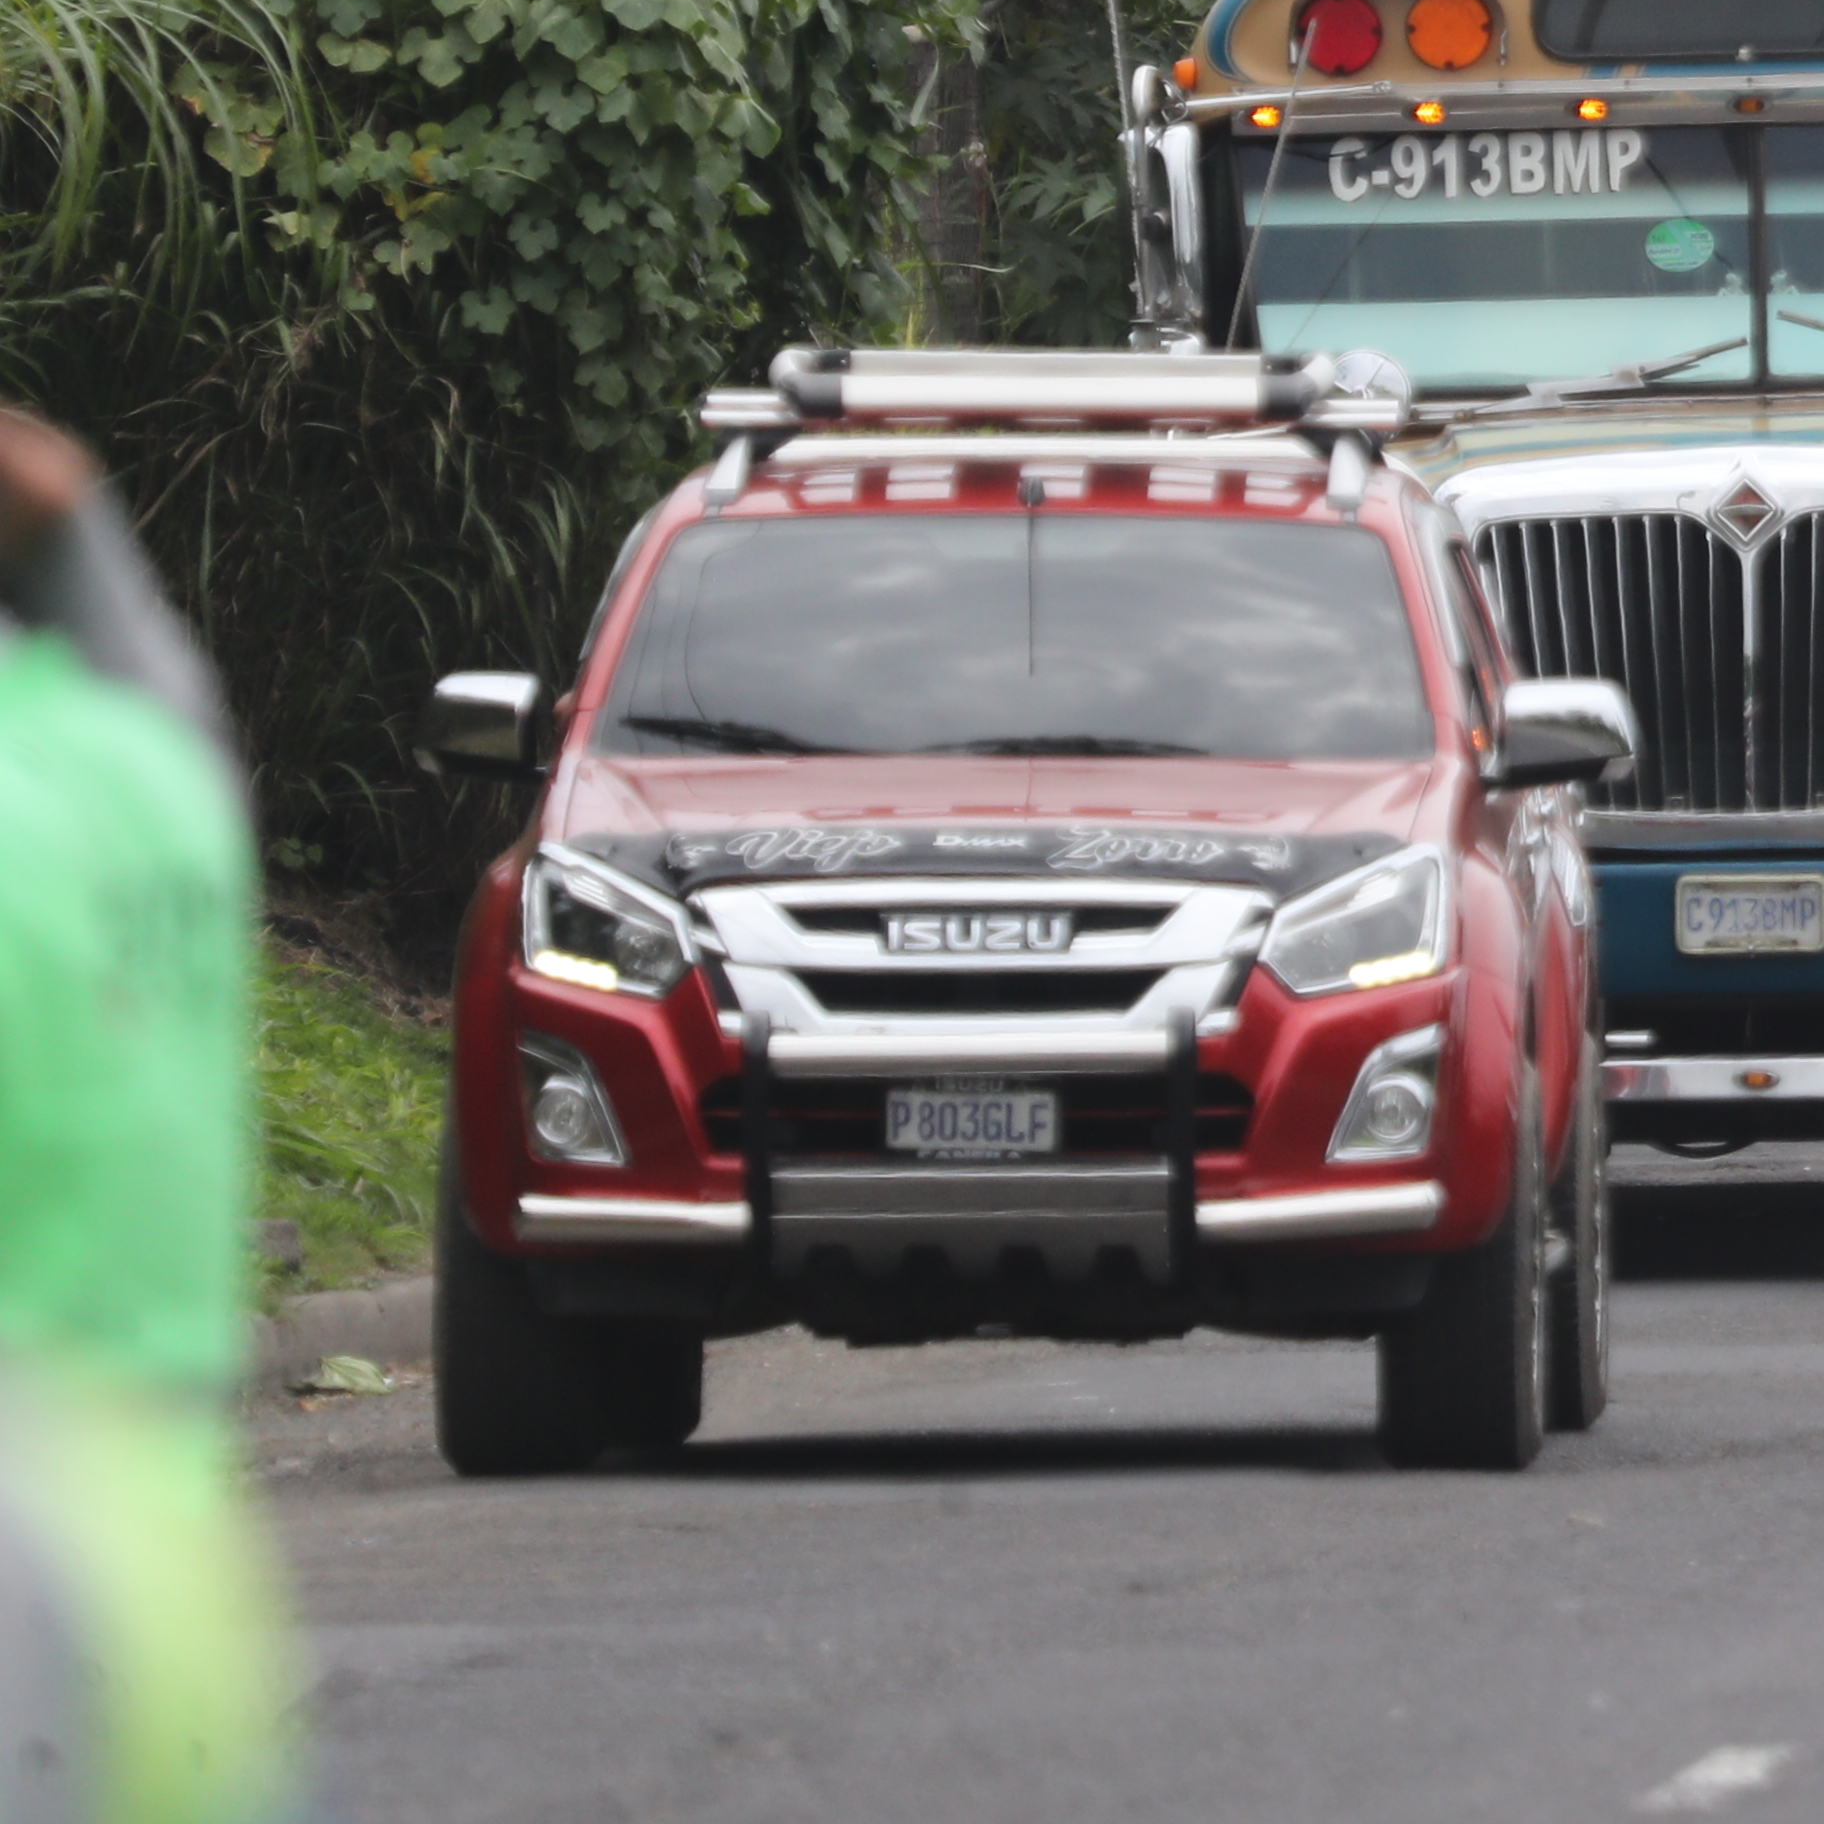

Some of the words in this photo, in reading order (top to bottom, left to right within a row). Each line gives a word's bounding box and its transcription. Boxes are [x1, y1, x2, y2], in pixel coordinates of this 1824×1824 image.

[1327, 127, 1644, 203] C-913BMP
[886, 915, 1066, 952] ISUZU
[1686, 896, 1816, 933] C913BMP
[891, 1099, 1050, 1143] P803GLF
